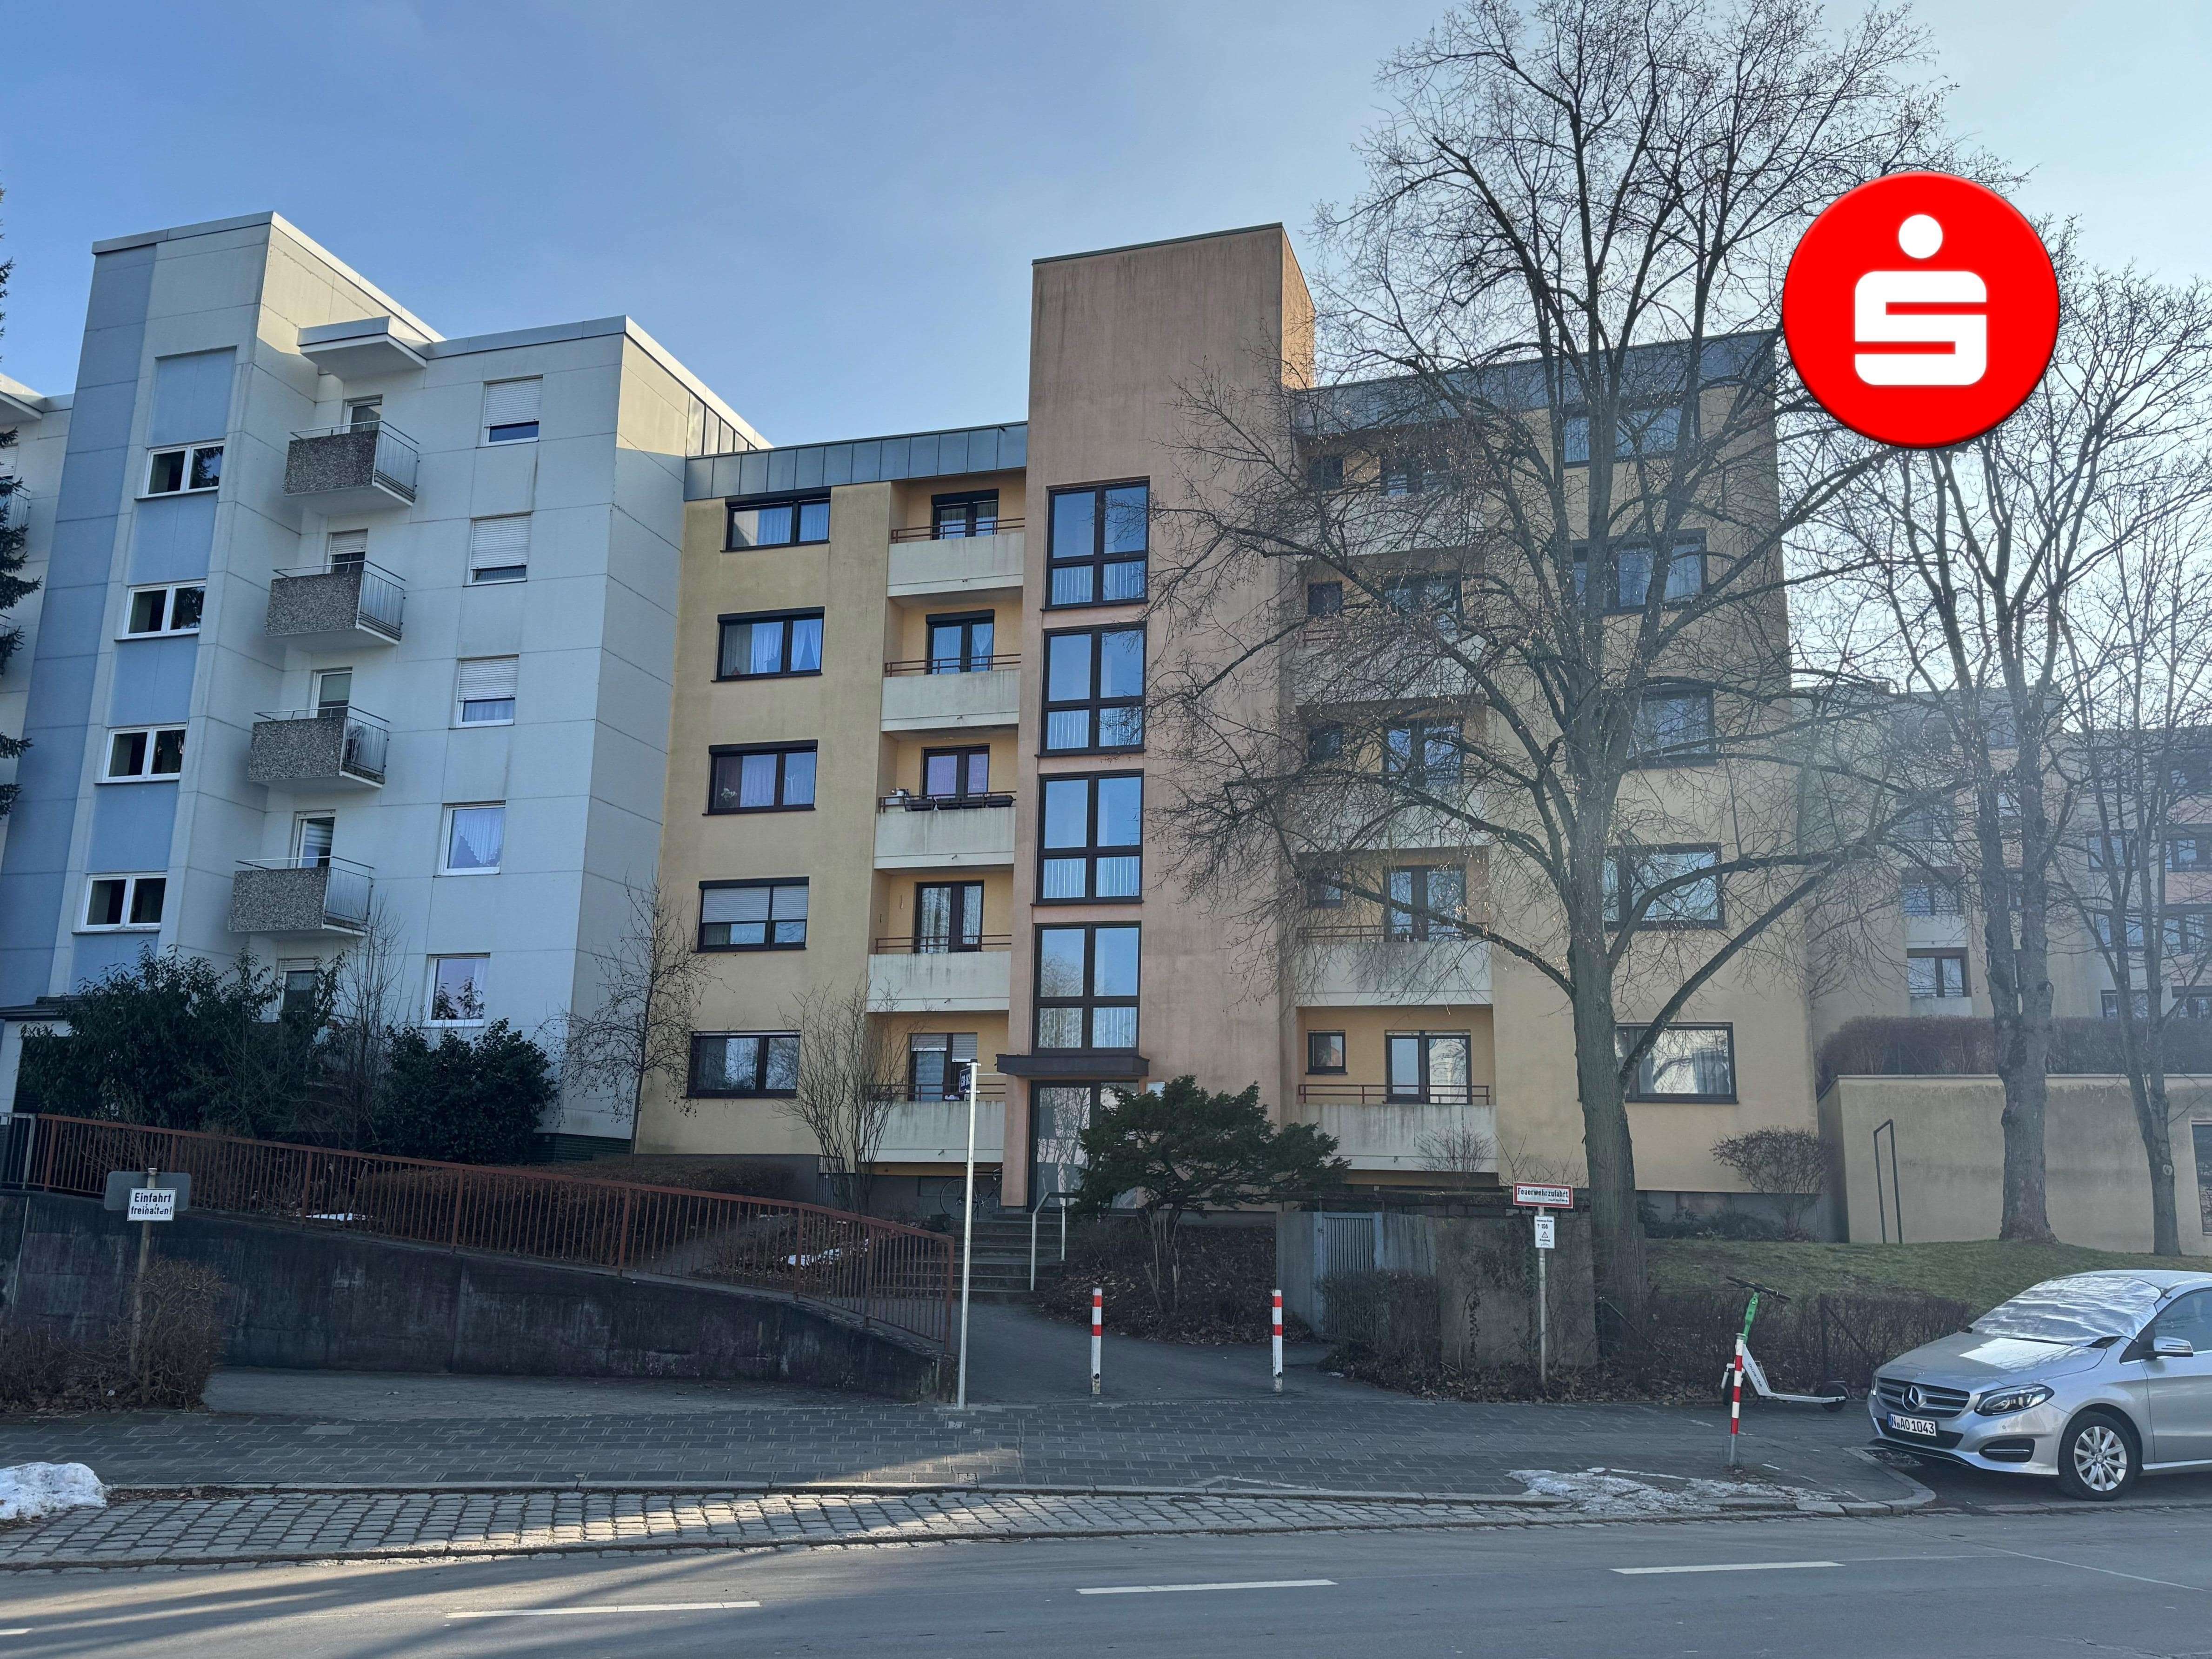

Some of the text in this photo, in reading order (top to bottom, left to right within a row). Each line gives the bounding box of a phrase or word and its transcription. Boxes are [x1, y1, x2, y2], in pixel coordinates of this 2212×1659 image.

[134, 1193, 171, 1202] Einfahrt
[1518, 1187, 1568, 1198] Feuerwehrzufahrt
[131, 1204, 172, 1215] freihalten!
[1891, 1415, 1934, 1434] N AO 1043
